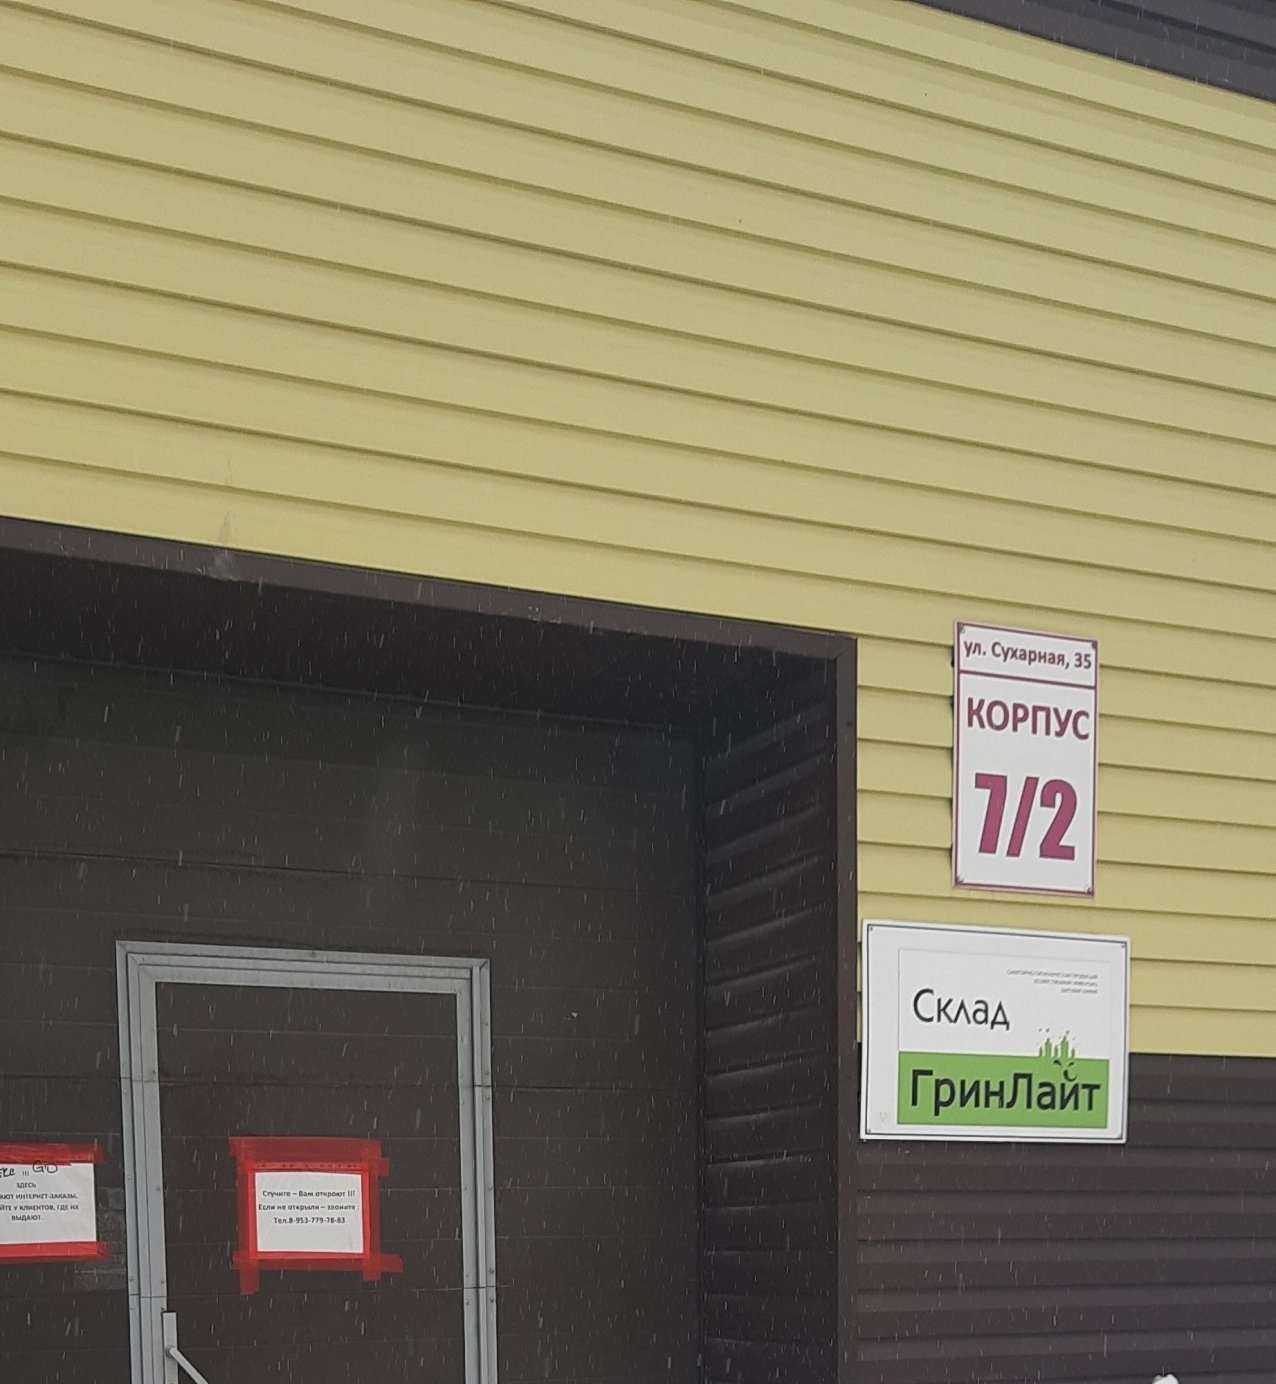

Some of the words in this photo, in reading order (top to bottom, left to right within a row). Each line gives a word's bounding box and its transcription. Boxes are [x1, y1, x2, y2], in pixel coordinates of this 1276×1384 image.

[963, 641, 986, 658] ул.
[991, 641, 1070, 670] Сухарная,
[1074, 652, 1092, 670] 35
[967, 696, 1090, 741] КОРПУС
[974, 772, 1078, 861] 7/2
[913, 988, 1010, 1031] Склад
[911, 1067, 1102, 1117] ГринЛайт
[258, 1203, 276, 1211] Если
[288, 1204, 320, 1212] открыли
[262, 1190, 291, 1198] Стучите
